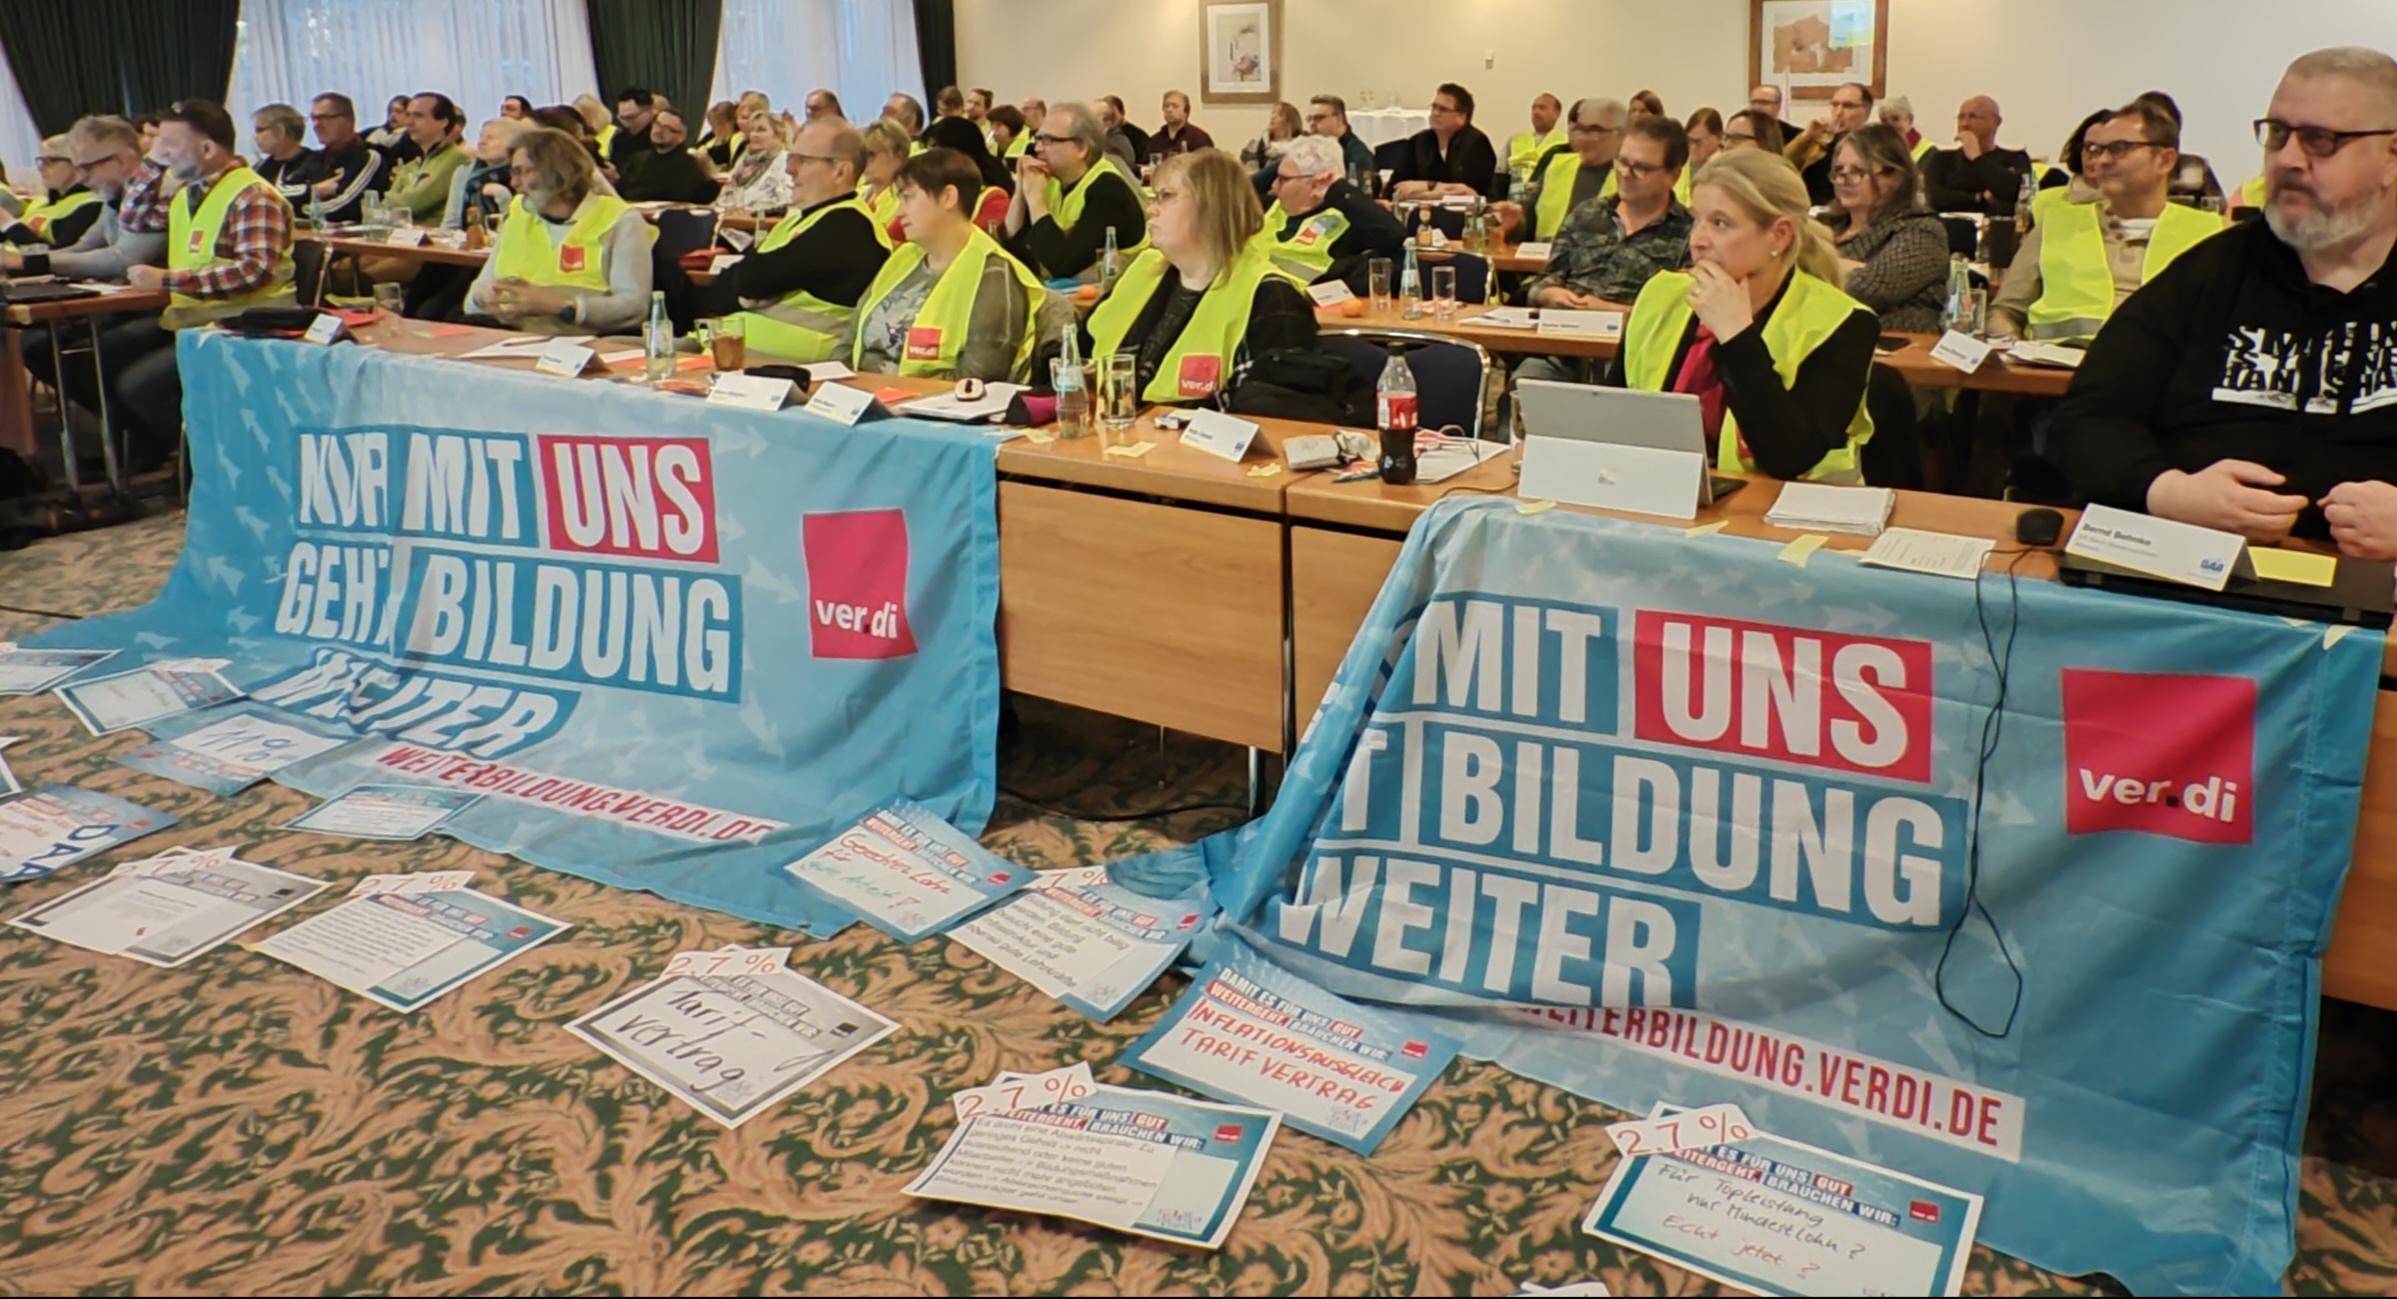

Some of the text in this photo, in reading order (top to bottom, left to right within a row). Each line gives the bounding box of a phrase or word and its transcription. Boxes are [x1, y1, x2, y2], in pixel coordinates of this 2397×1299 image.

[1181, 379, 1216, 392] ver.d
[403, 432, 522, 539] MIT
[553, 442, 704, 555] UNS
[408, 554, 730, 692] BILDUNG
[816, 600, 897, 639] ver.di
[1412, 600, 1908, 768] MIT UNS
[2080, 768, 2237, 822] ver.di
[1440, 731, 1943, 926] BILDUNG
[1279, 856, 1677, 1008] WEITER
[1219, 968, 1260, 998] DAMIT
[1257, 990, 1277, 1007] ES
[1301, 1011, 1330, 1027] UNS
[1331, 1020, 1362, 1038] GUT
[1290, 1019, 1359, 1053] BRAUCHEN
[1044, 1074, 1087, 1102] %
[1180, 1027, 1377, 1109] TARIF VERTRAG
[1518, 1007, 2003, 1147] EITERBILDUNG.VERDI.DE
[1089, 1121, 1167, 1142] BRAUCHEN
[1100, 1109, 1128, 1123] UNS
[1135, 1113, 1167, 1130] GUT
[1698, 1112, 1749, 1145] %
[1670, 1149, 1761, 1183] EITERGEHT,
[1764, 1176, 1853, 1212] BRAUCHEN
[1858, 1202, 1899, 1227] WIR:
[1716, 1145, 1851, 1197] ES FÜR UNS GUT
[1799, 1261, 1822, 1280] ?
[1850, 1242, 1866, 1261] ?
